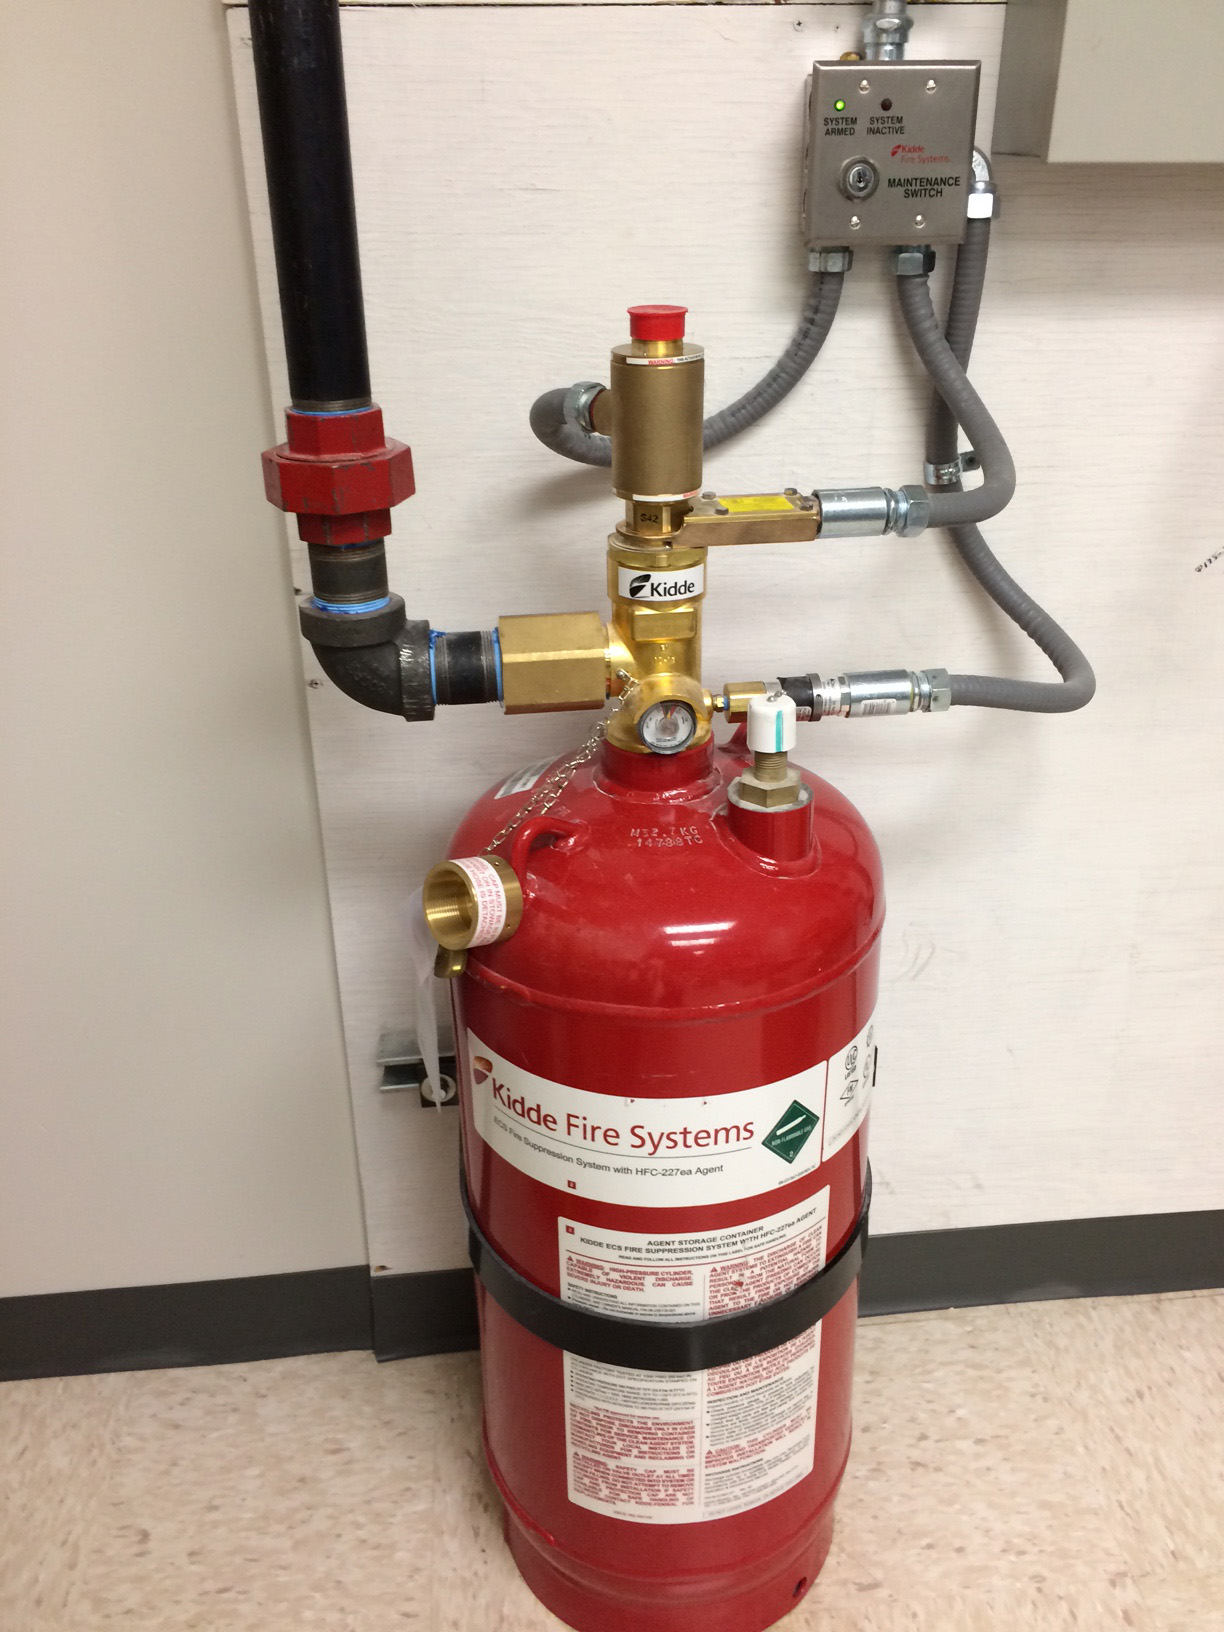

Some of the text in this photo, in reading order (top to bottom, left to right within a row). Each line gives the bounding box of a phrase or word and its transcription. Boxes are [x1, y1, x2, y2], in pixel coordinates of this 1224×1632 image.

[823, 117, 858, 126] SYSTEM
[869, 116, 904, 125] SYSTEM
[824, 127, 856, 136] ARMED
[866, 126, 905, 135] INACTIVE
[887, 176, 961, 188] MAINTENANCE
[903, 188, 943, 198] SWITCH
[640, 513, 659, 524] S42
[650, 580, 695, 597] Kidde
[492, 1077, 755, 1156] Kidde Fire Systems
[509, 1128, 522, 1142] Fire
[523, 1137, 574, 1163] Suppression
[576, 1157, 610, 1172] System
[613, 1166, 633, 1175] with
[635, 1168, 692, 1177] HFC-227ea
[694, 1164, 724, 1176] Agent
[580, 1237, 603, 1248] KIDDE
[606, 1243, 622, 1251] ECS
[645, 1246, 704, 1254] SUPPRESSION
[706, 1240, 738, 1251] SYSTEM
[796, 1207, 817, 1224] AGENT
[678, 1237, 718, 1246] STORAGE
[720, 1226, 764, 1241] CONTAINER
